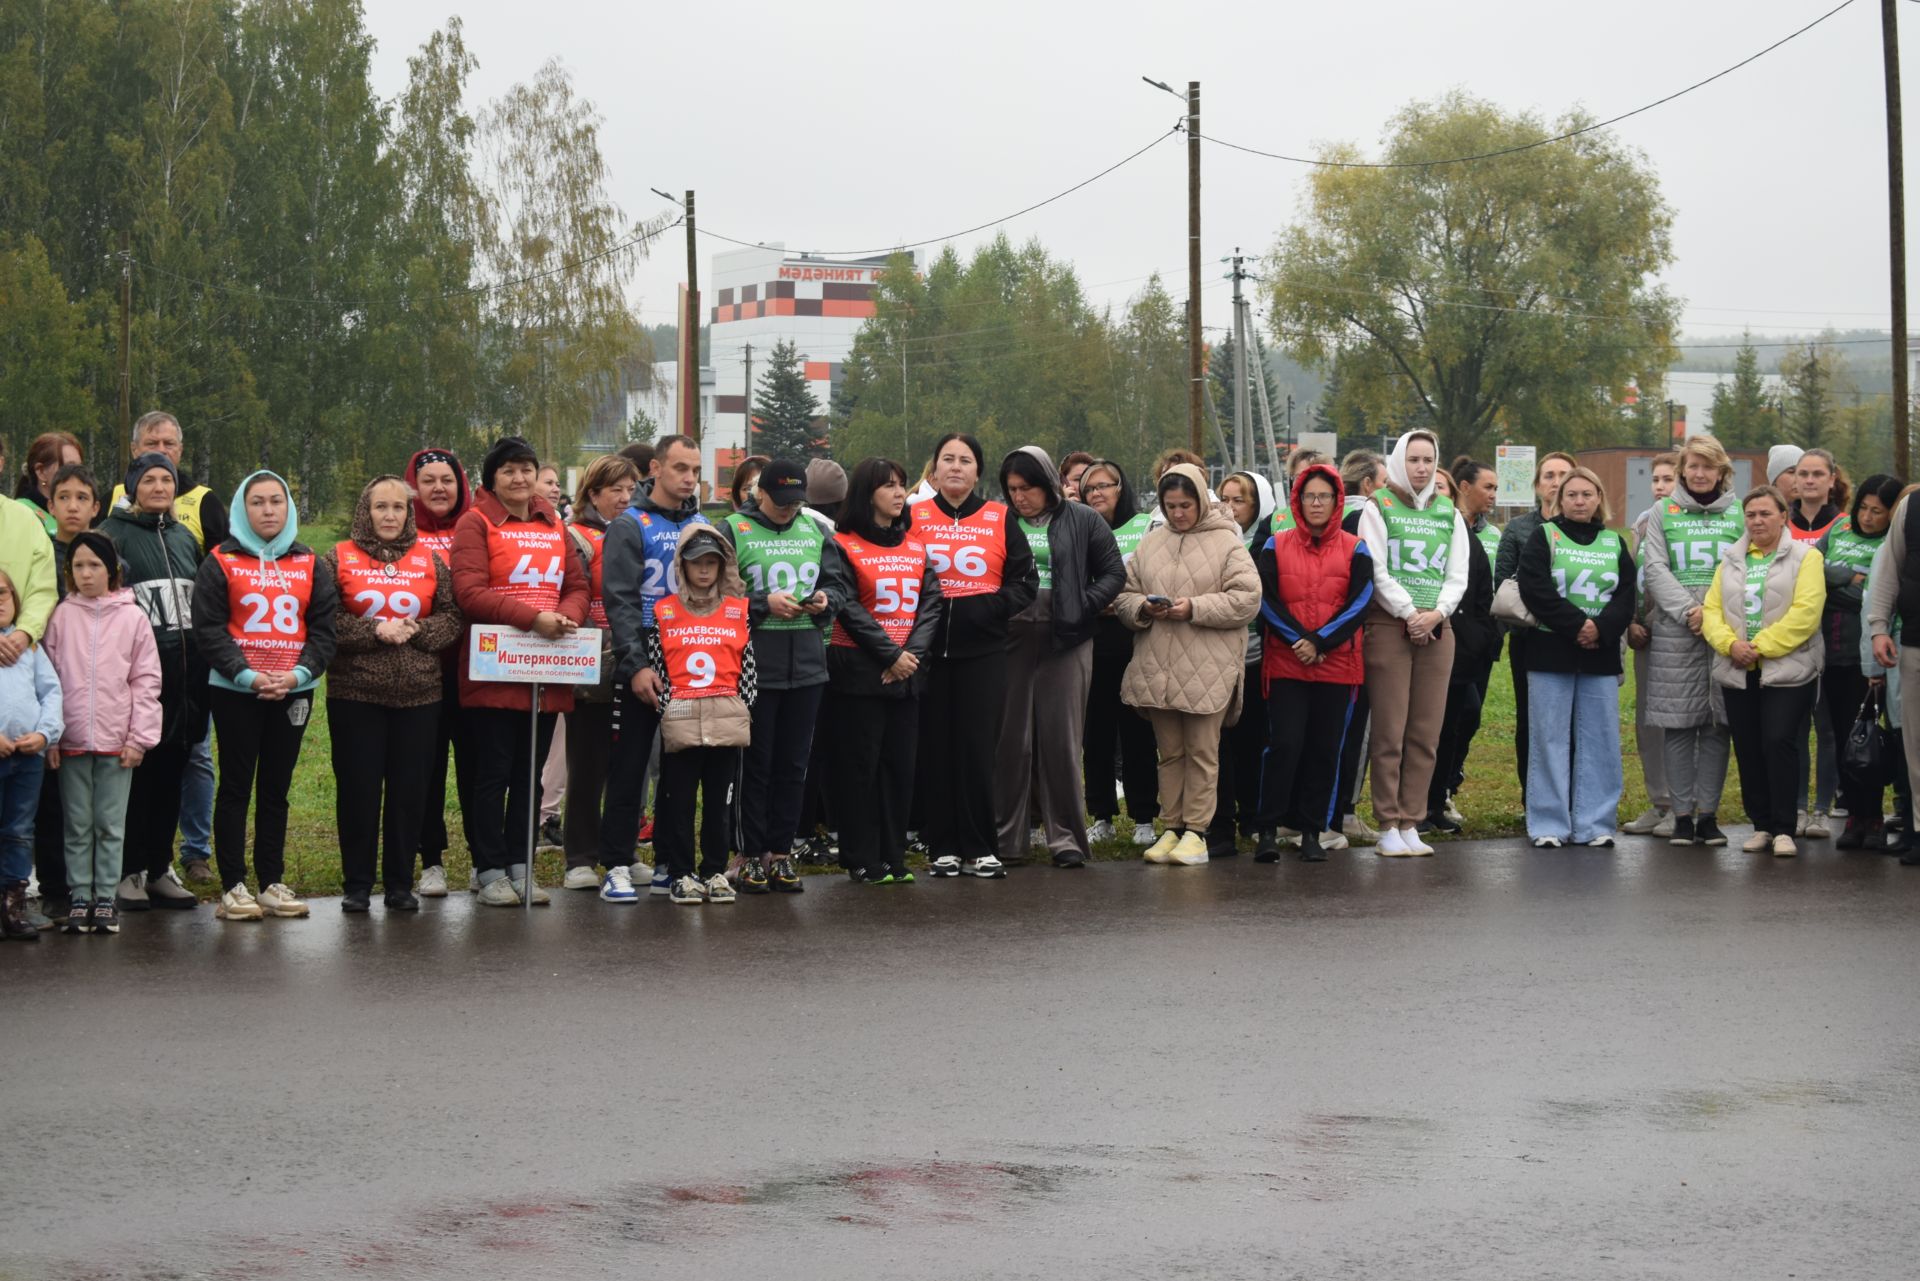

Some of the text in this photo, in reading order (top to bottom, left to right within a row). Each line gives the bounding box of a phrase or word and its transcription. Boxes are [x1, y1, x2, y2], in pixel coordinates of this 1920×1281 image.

[778, 266, 864, 282] МӘДӘНИЯТ
[1389, 516, 1450, 528] ТУКАЕВСКИЙ
[1672, 520, 1736, 528] ТУКАЕСКИЙ
[500, 531, 561, 541] ТУКАЕВСКИЙ
[921, 524, 994, 536] ТУКАЕВСКИЙ
[936, 532, 976, 540] РАЙОН
[1404, 526, 1436, 536] РАЙОН
[1688, 528, 1722, 536] РАЙОН
[518, 540, 552, 549] РАЙОН
[747, 538, 816, 549] ТУКАЕВСКИЙ
[765, 547, 804, 556] РАЙОН
[1388, 539, 1448, 575] 134
[1555, 548, 1617, 560] ТУКАЕВСКИЙ
[860, 556, 923, 566] ТУКАЕВСКИЙ
[926, 544, 988, 577] 56
[1570, 556, 1606, 566] РАЙОН
[351, 568, 425, 578] ТУКАЕСКИЙ
[509, 554, 564, 590] 44
[878, 562, 913, 572] РАЙОН
[367, 577, 410, 586] РАЙОН
[746, 561, 820, 598] 109
[1551, 568, 1619, 602] 142
[874, 578, 920, 613] 55
[354, 590, 420, 622] 29
[240, 592, 299, 634] 28
[666, 626, 736, 638] ТУКАЕВСКИЙ
[682, 634, 721, 646] РАЙОН
[498, 650, 596, 667] Иштеряковское
[686, 652, 716, 688] 9
